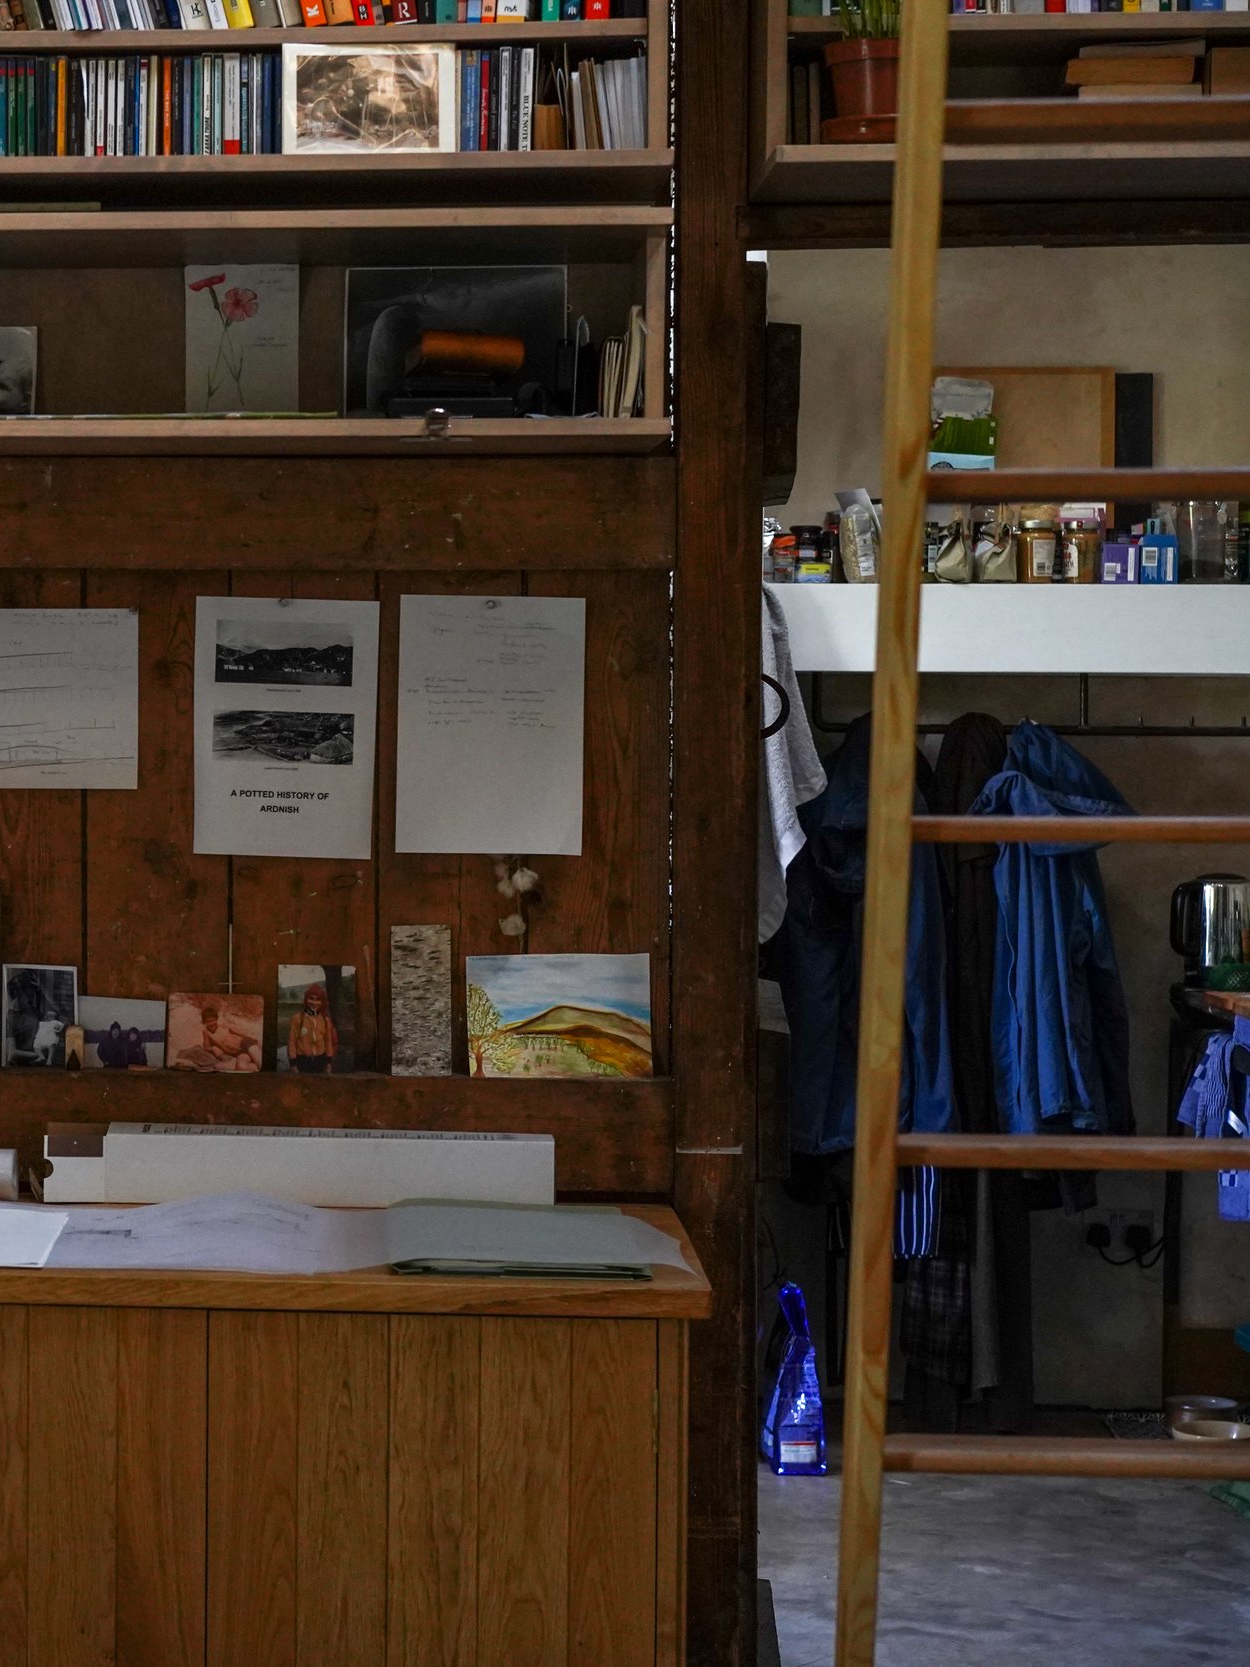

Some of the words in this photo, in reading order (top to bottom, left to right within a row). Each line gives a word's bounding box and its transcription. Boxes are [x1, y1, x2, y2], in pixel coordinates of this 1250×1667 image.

[522, 95, 530, 118] BLUE
[521, 119, 529, 143] NOTE
[239, 790, 275, 799] POTTED
[276, 791, 316, 800] HISTORY
[317, 792, 330, 800] OF
[260, 805, 300, 814] ARDNISH
